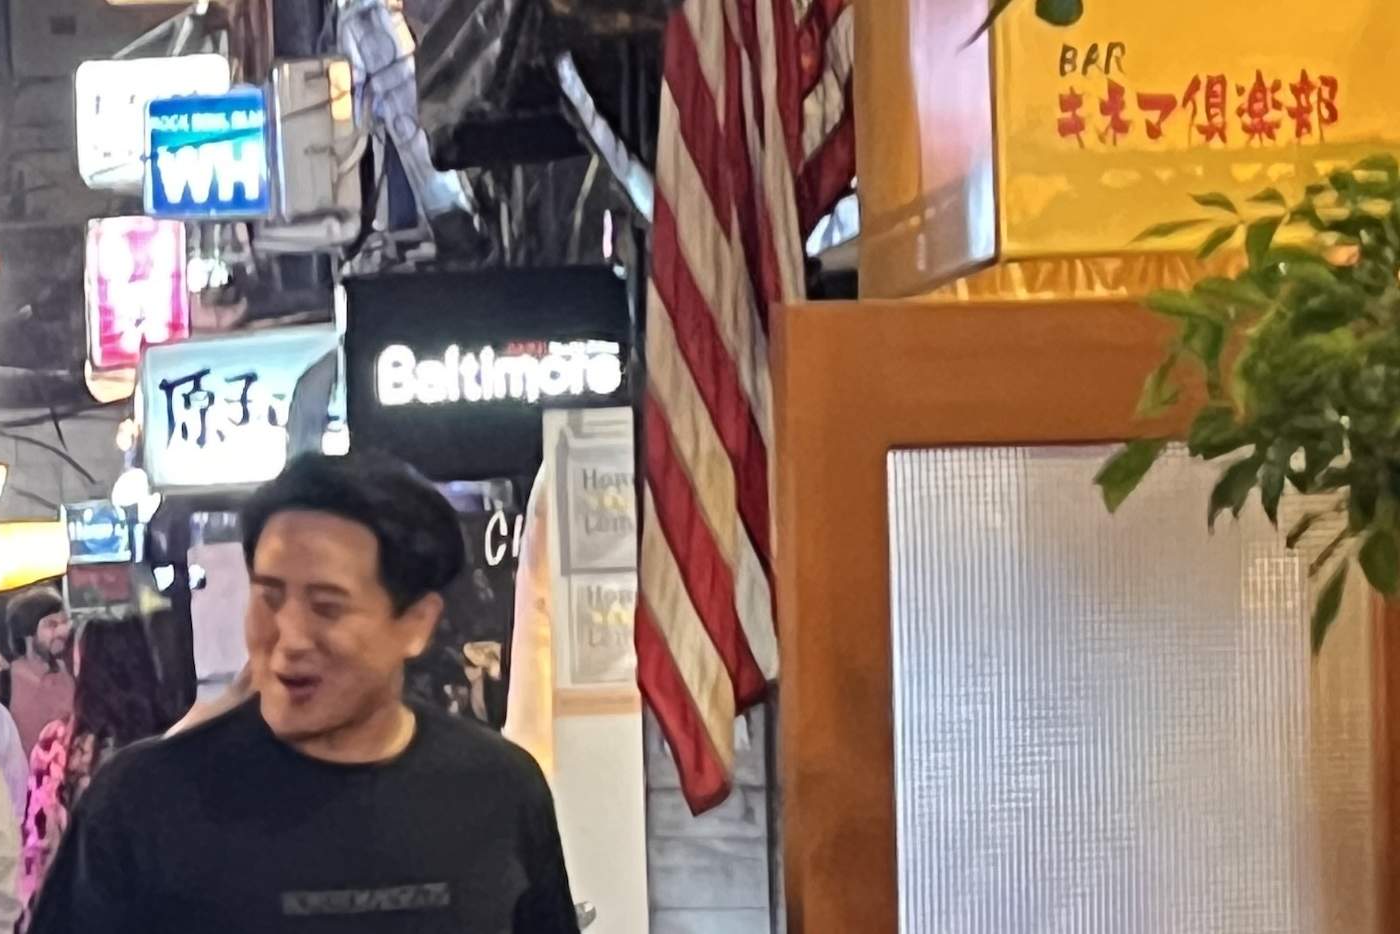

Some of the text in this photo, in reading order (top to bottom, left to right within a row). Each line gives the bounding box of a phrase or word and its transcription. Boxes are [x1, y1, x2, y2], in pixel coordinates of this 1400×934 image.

[1059, 41, 1126, 77] BAR
[1057, 68, 1338, 148] キネマ倶楽部
[377, 343, 622, 406] Baltimore
